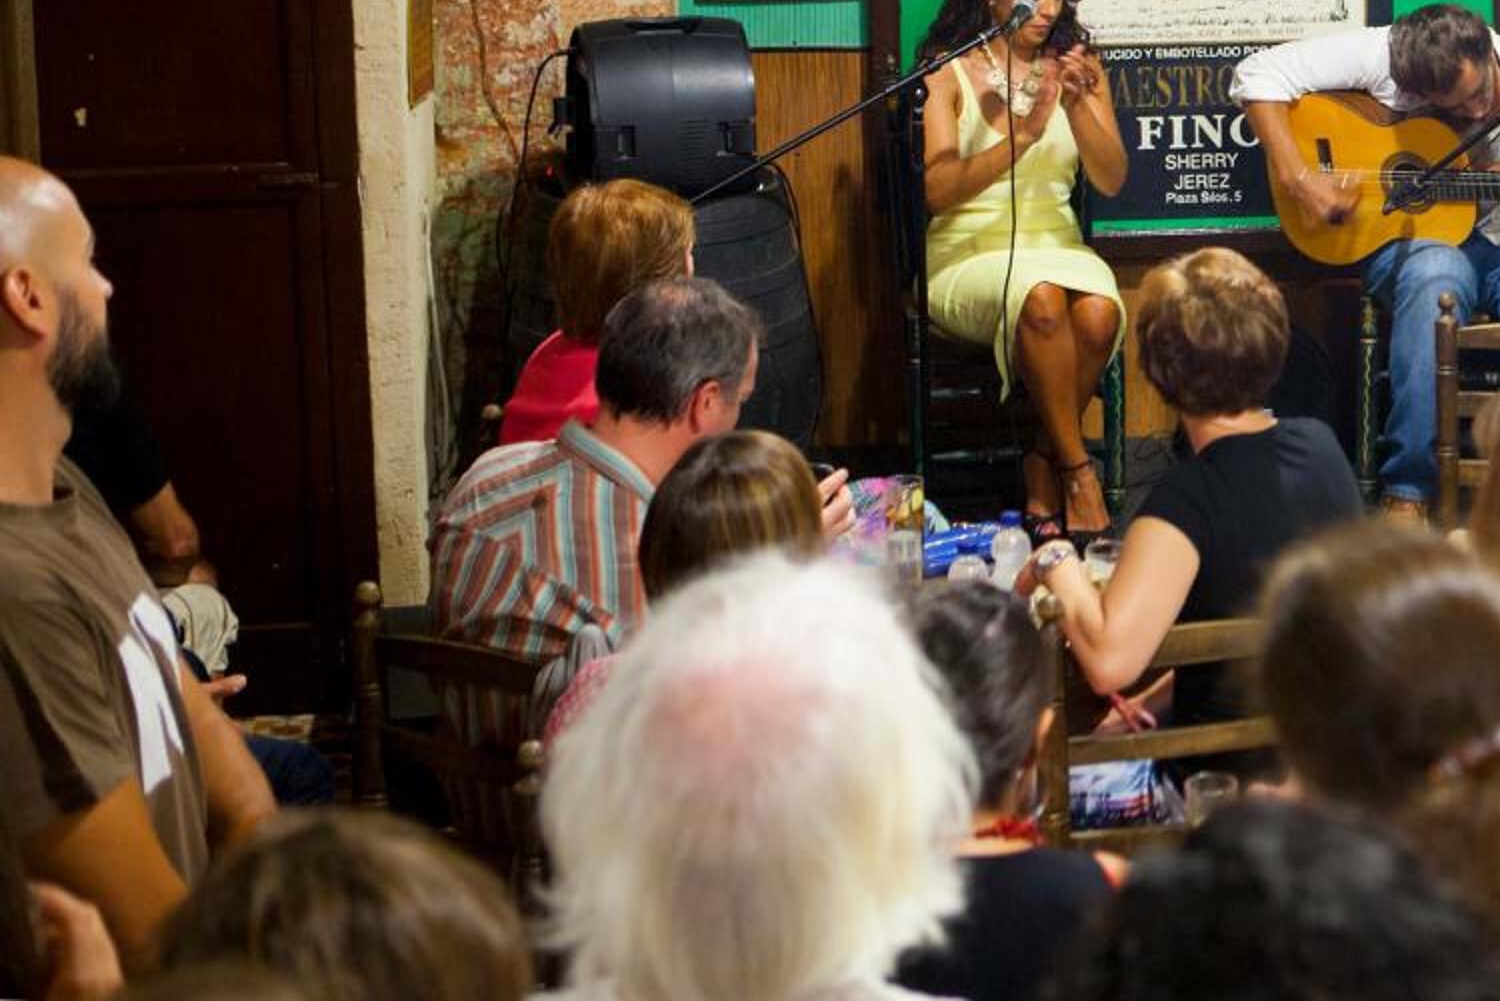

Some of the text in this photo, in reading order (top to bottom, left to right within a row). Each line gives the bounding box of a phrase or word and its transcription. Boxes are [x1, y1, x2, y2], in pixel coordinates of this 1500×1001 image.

[1144, 48, 1153, 59] Y
[1155, 46, 1240, 59] EMBOTELLADO
[1165, 153, 1239, 170] SHERRY
[1174, 174, 1231, 190] JEREZ
[1165, 192, 1198, 204] Plaza
